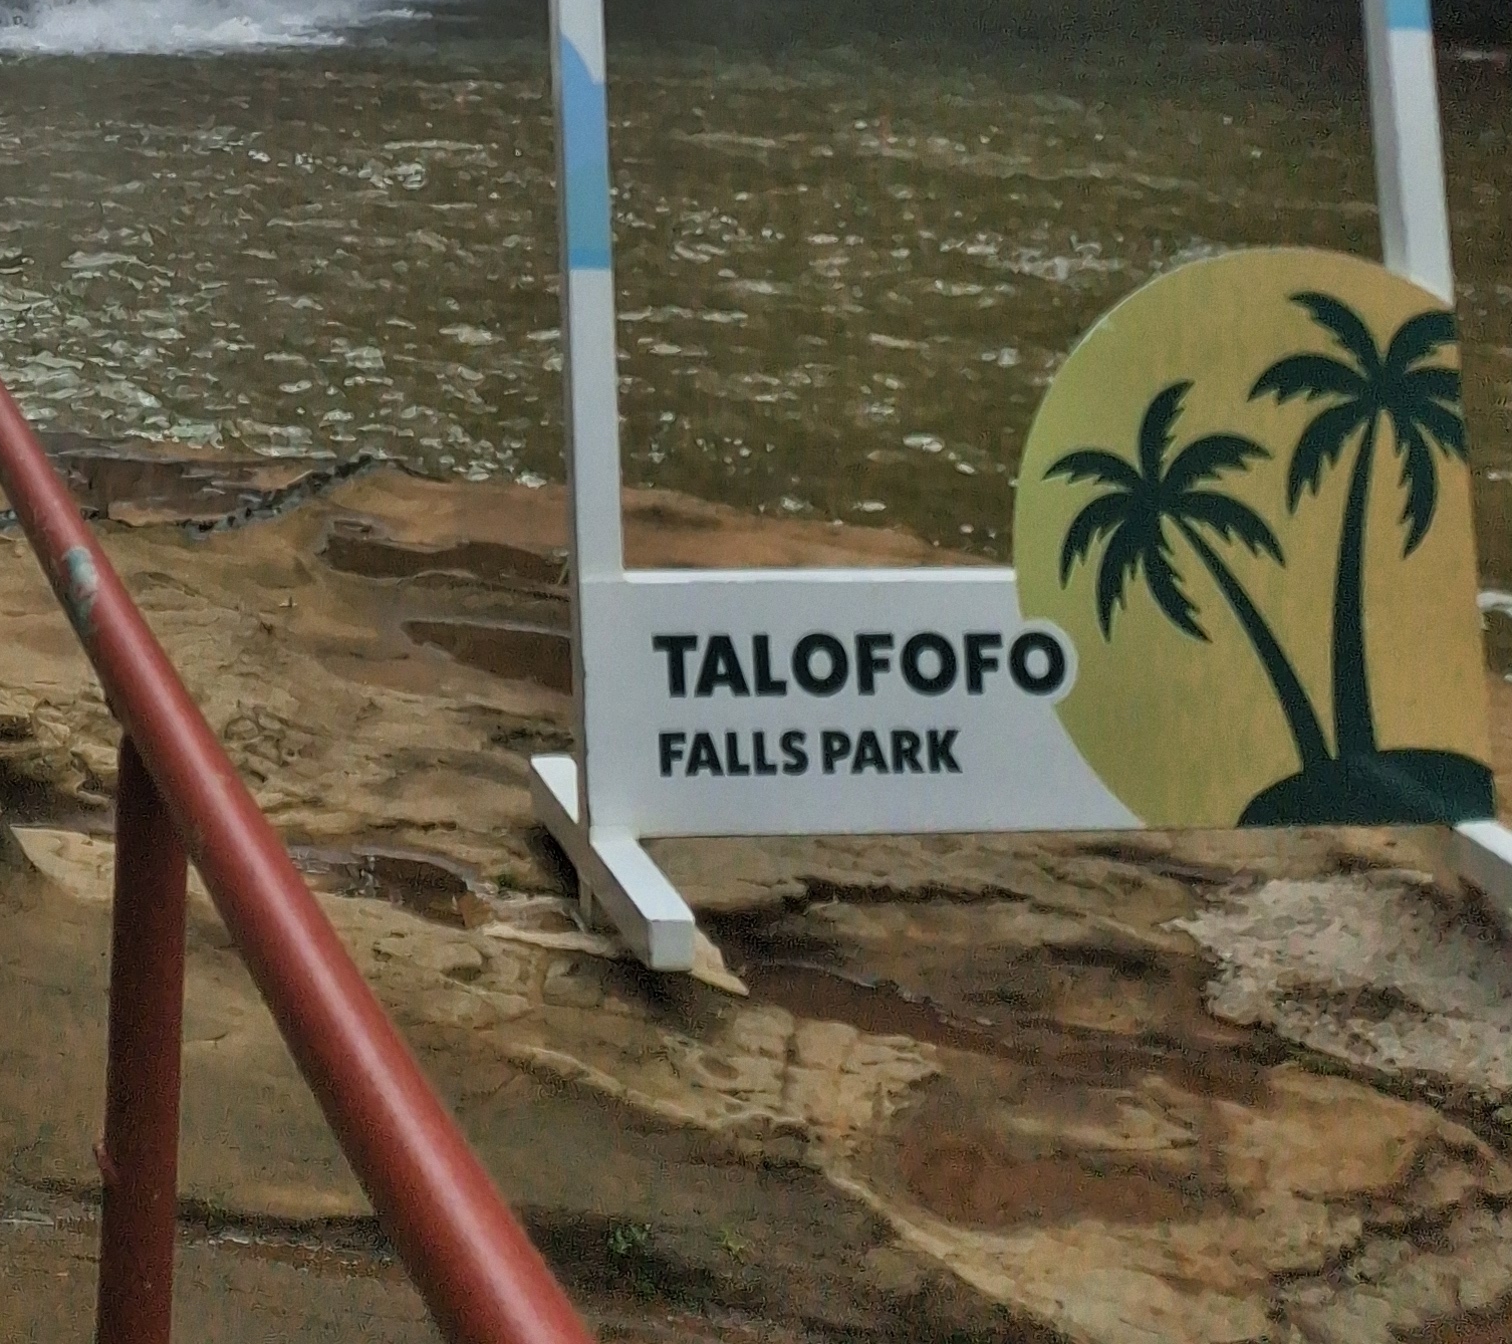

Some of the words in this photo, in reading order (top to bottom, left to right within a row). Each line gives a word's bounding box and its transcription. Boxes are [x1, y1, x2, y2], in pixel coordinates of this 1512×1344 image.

[651, 631, 1067, 698] TALOFOFO
[658, 729, 810, 778] FALLS
[821, 728, 963, 775] PARK
